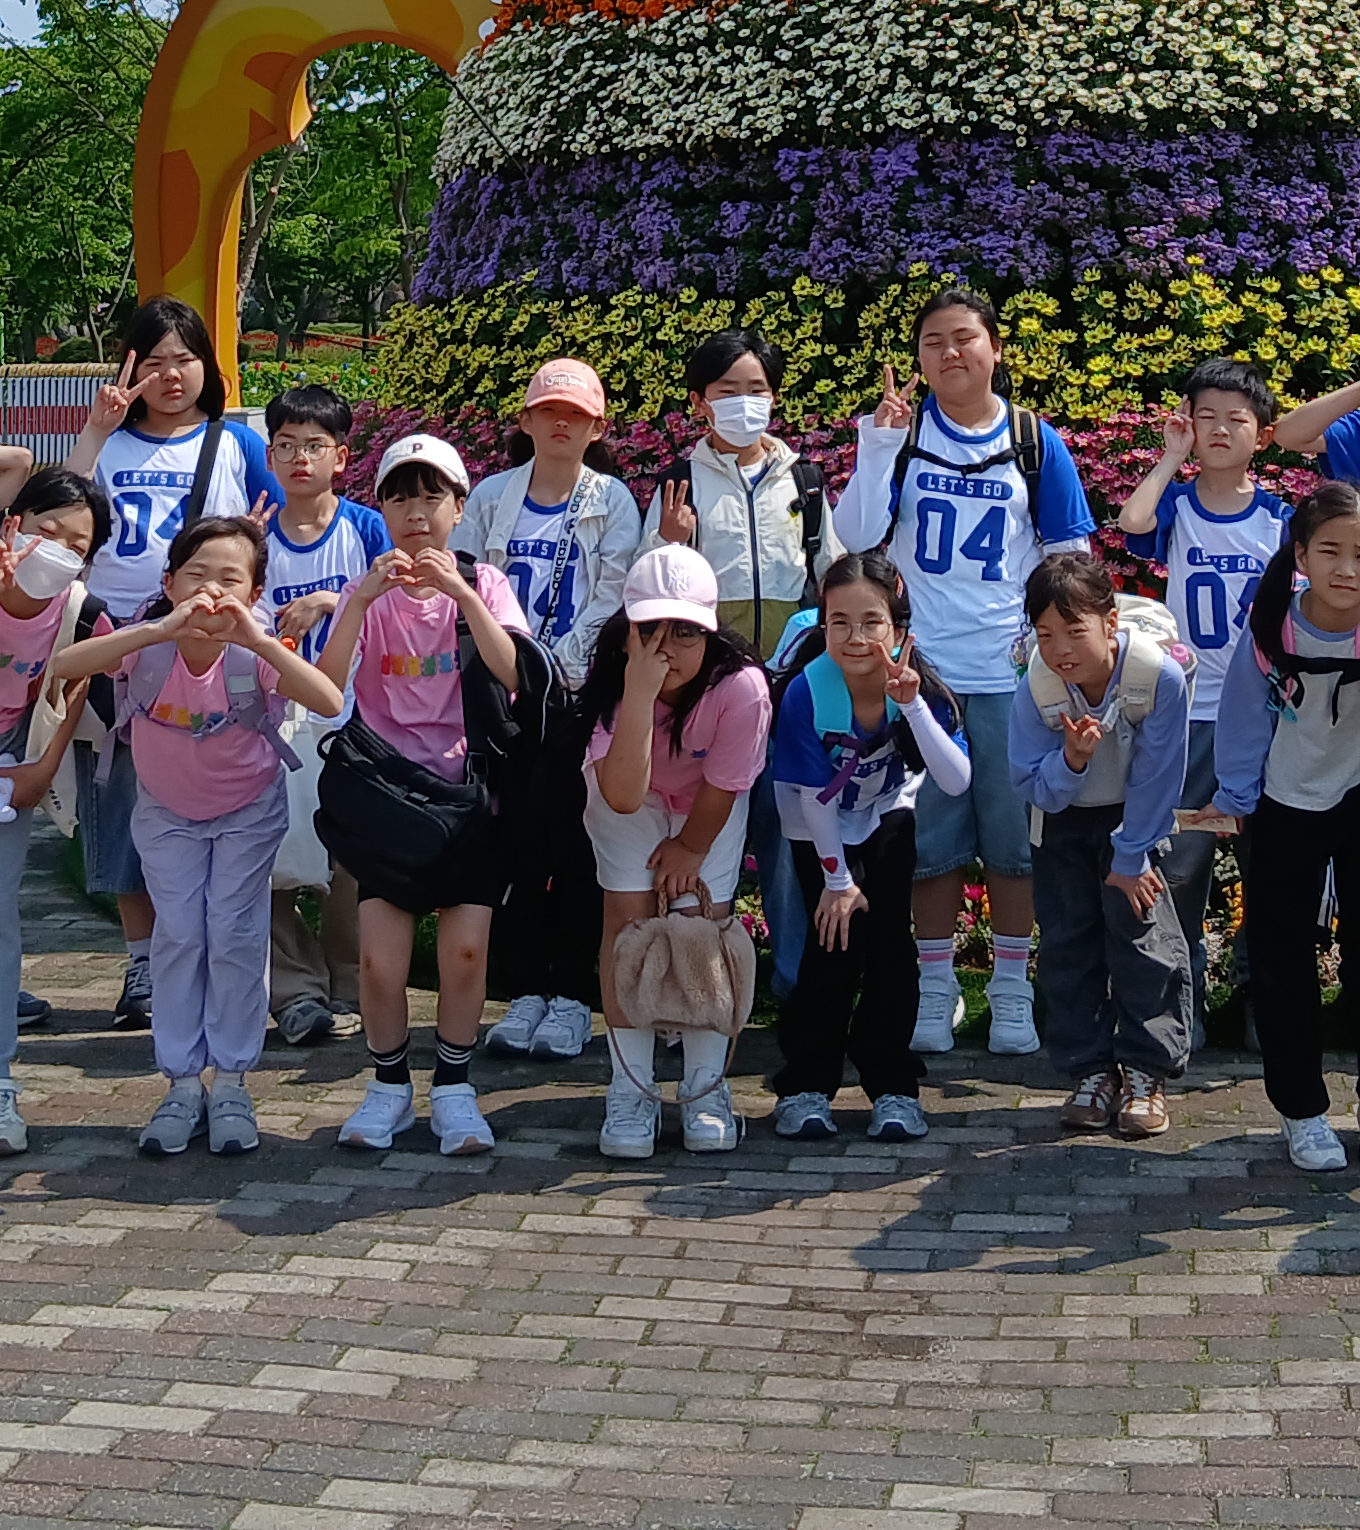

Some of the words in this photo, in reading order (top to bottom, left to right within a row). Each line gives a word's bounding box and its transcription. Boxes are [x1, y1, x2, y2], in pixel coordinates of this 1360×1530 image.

[411, 442, 424, 454] P
[122, 472, 169, 485] LET'S
[176, 474, 195, 487] GO
[926, 475, 975, 495] LET'S
[982, 482, 1003, 497] GO
[914, 496, 1007, 582] 04
[509, 541, 550, 556] LET'S
[1195, 548, 1229, 571] LE'S
[1237, 556, 1257, 570] GO
